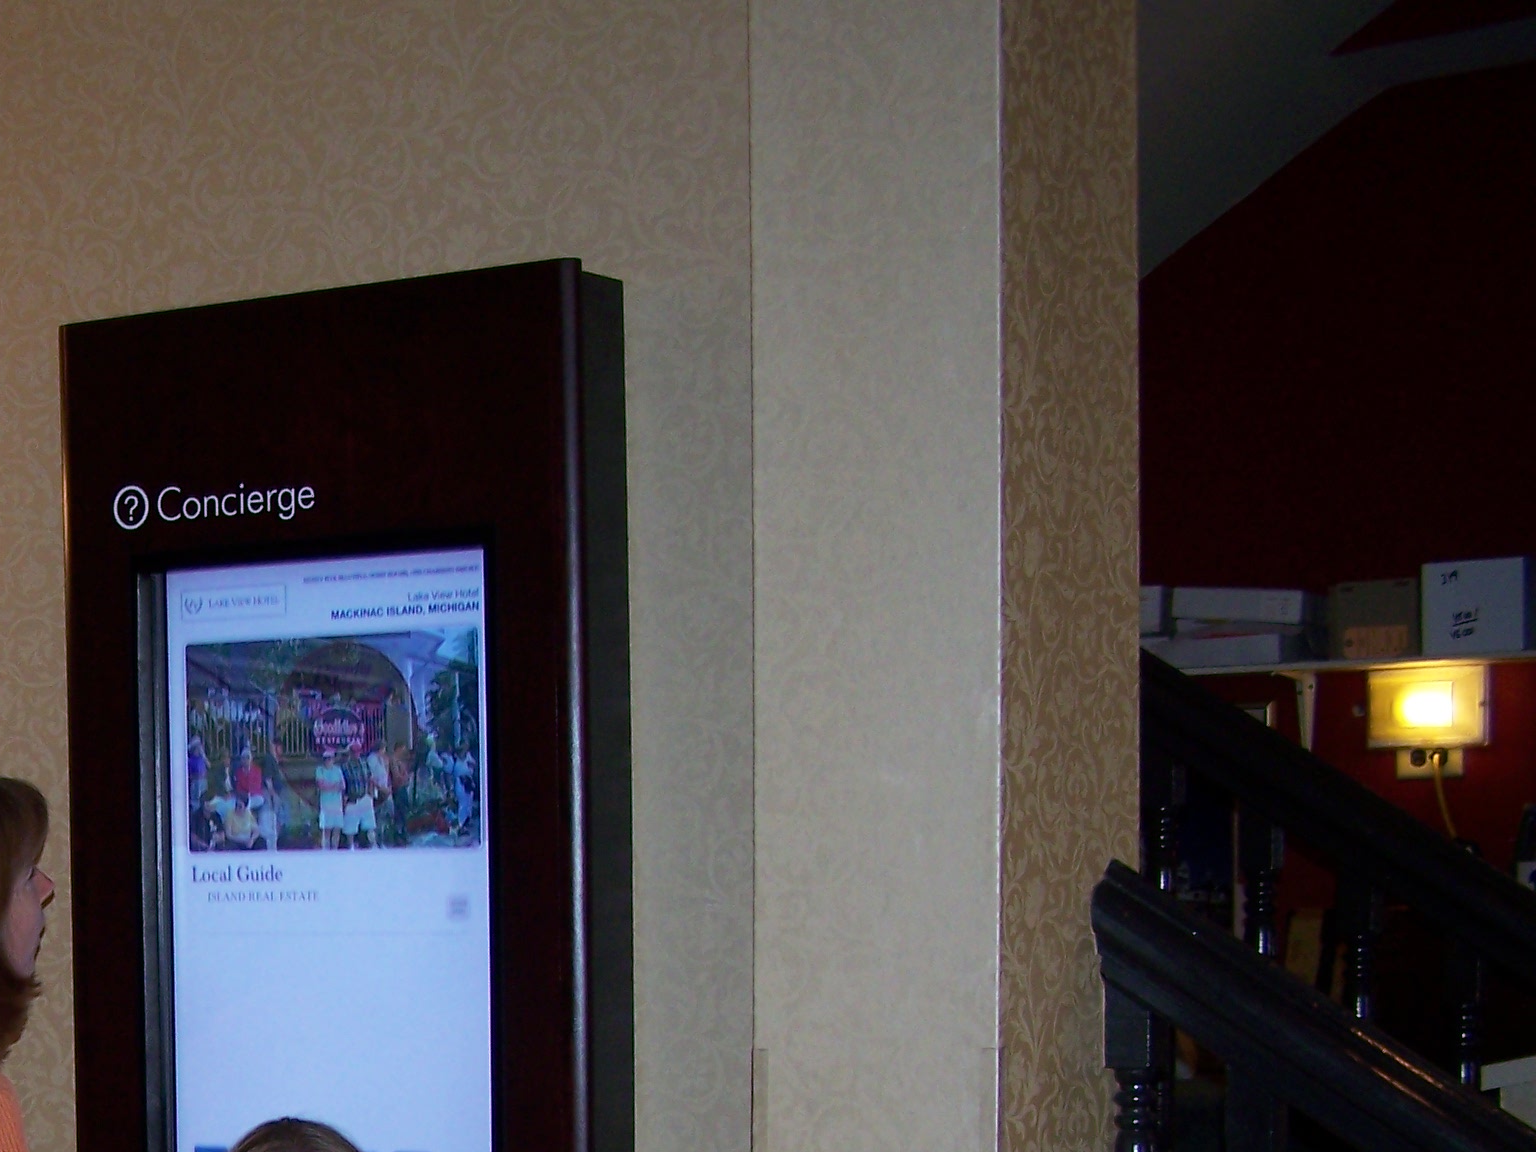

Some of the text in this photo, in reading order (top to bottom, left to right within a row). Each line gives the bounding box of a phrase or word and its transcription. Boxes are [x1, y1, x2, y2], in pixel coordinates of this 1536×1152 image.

[157, 483, 315, 520] Concierge
[331, 606, 384, 620] MACKINAC
[428, 601, 480, 615] MICHIGAN
[192, 864, 283, 883] Local Guide
